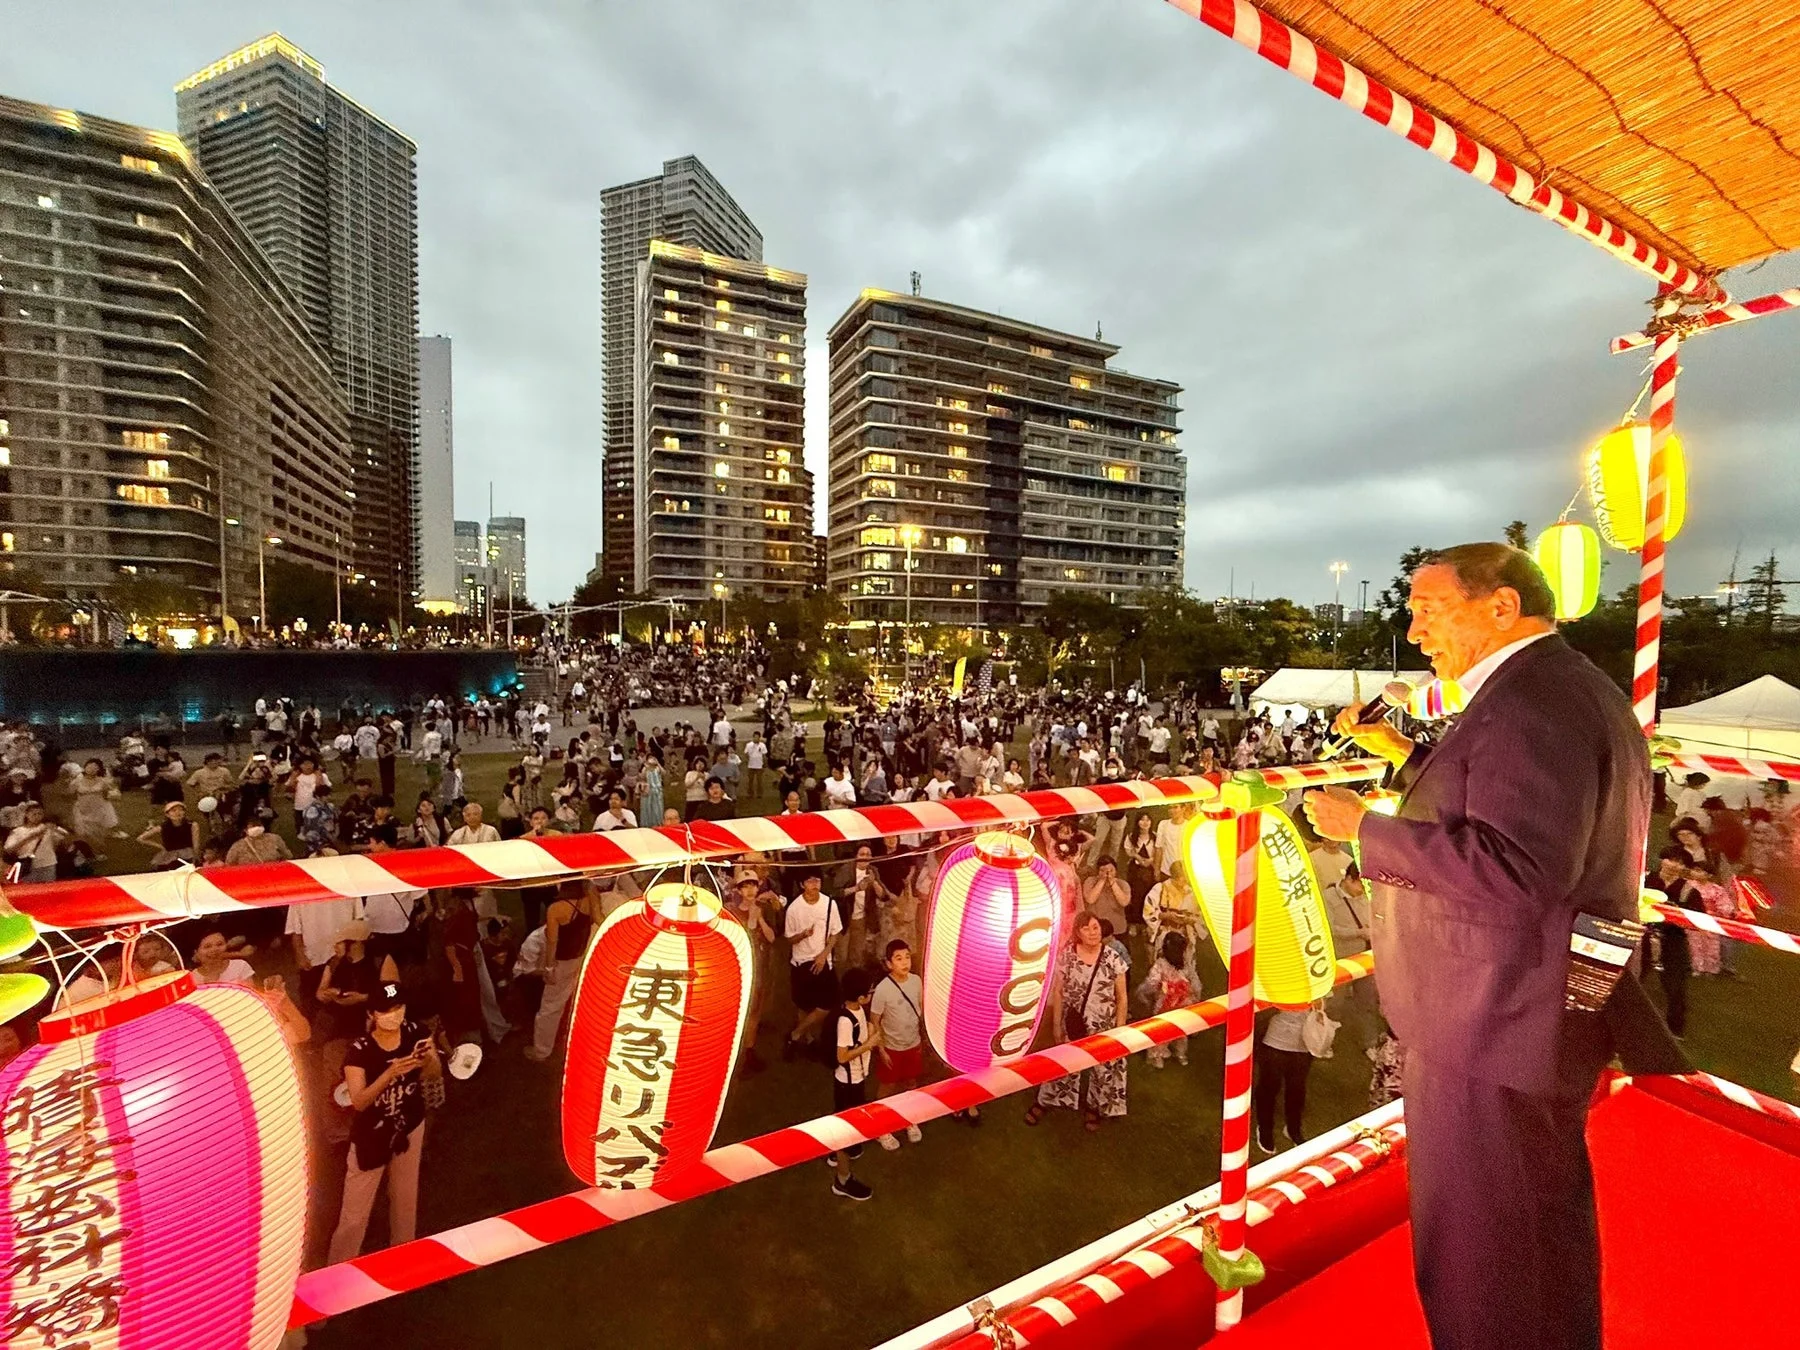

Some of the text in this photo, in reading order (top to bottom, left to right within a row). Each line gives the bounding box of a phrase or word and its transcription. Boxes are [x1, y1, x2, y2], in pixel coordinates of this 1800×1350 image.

[0, 1058, 138, 1350] 晴海歯科矯
[589, 963, 701, 1190] 東急リバブ
